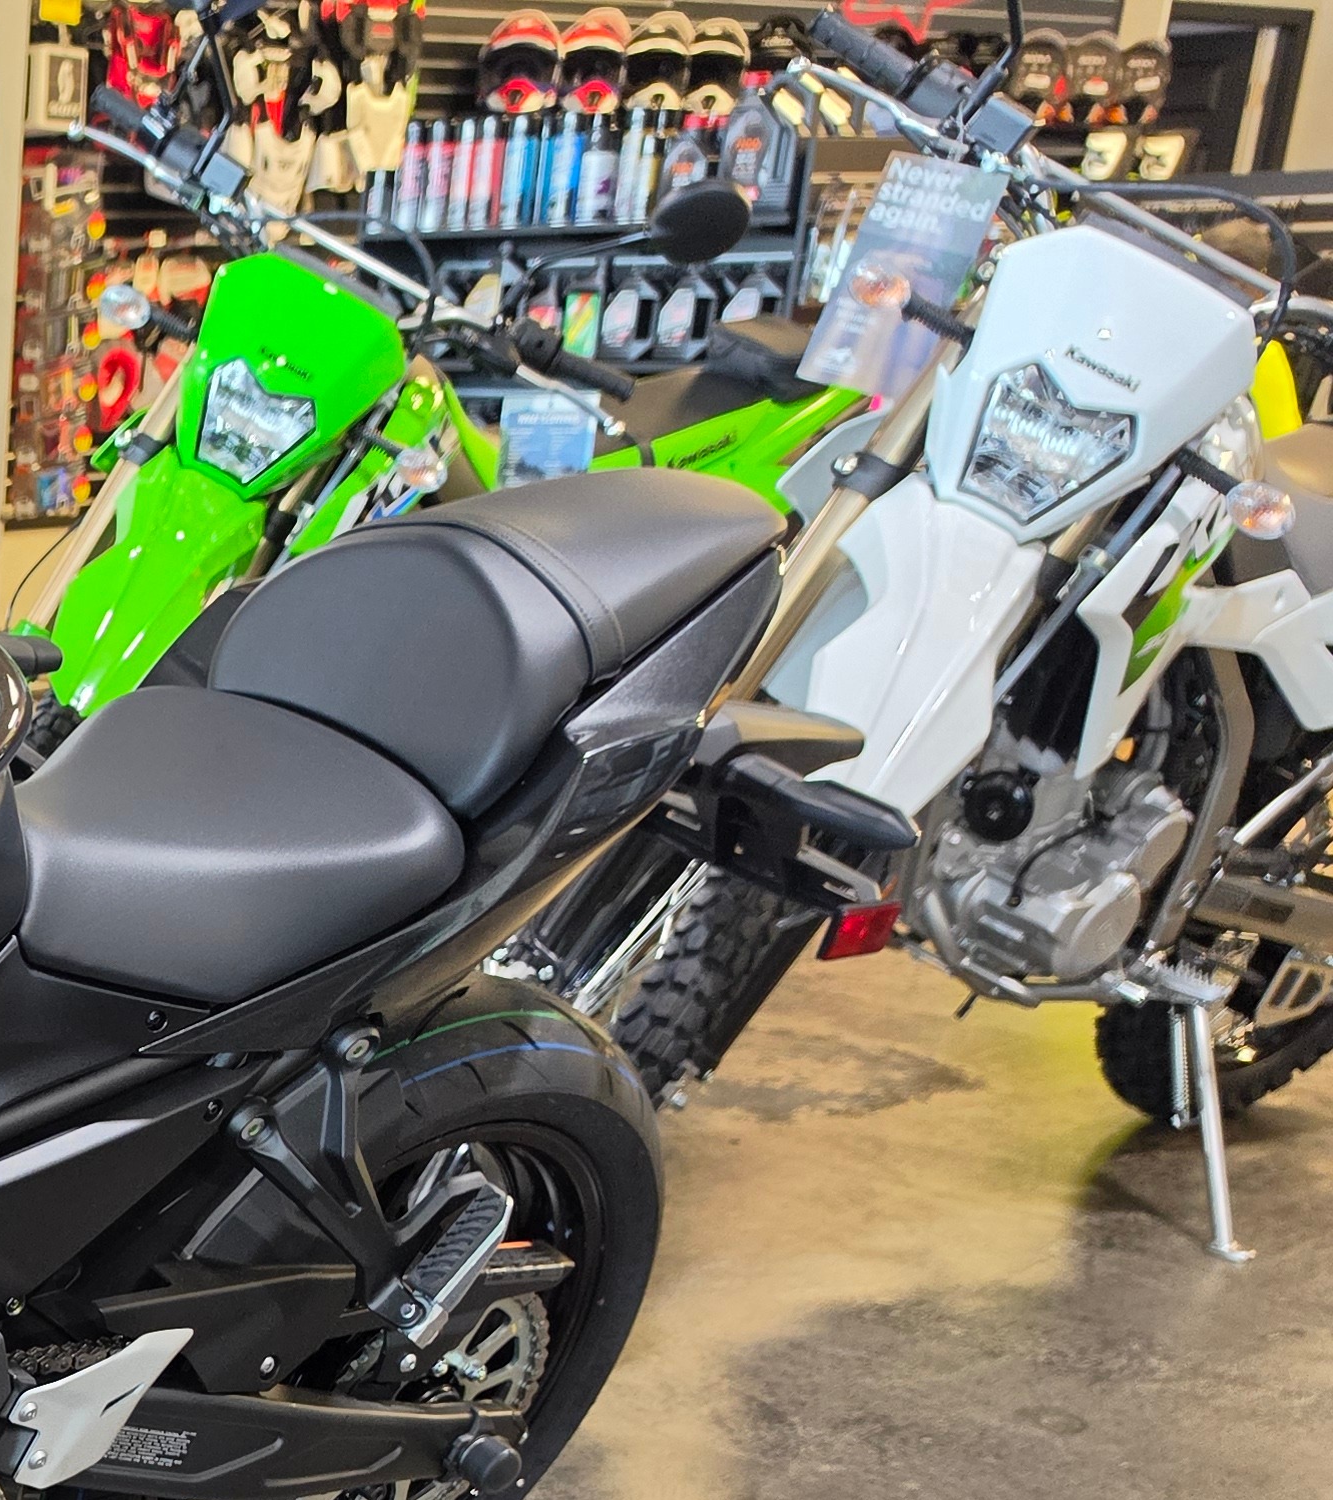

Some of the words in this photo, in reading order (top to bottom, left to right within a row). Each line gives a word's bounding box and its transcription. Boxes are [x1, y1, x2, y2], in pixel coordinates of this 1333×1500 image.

[886, 157, 962, 192] Never
[868, 201, 943, 234] again.
[878, 181, 991, 222] stranded
[1065, 344, 1141, 393] Kawasaki
